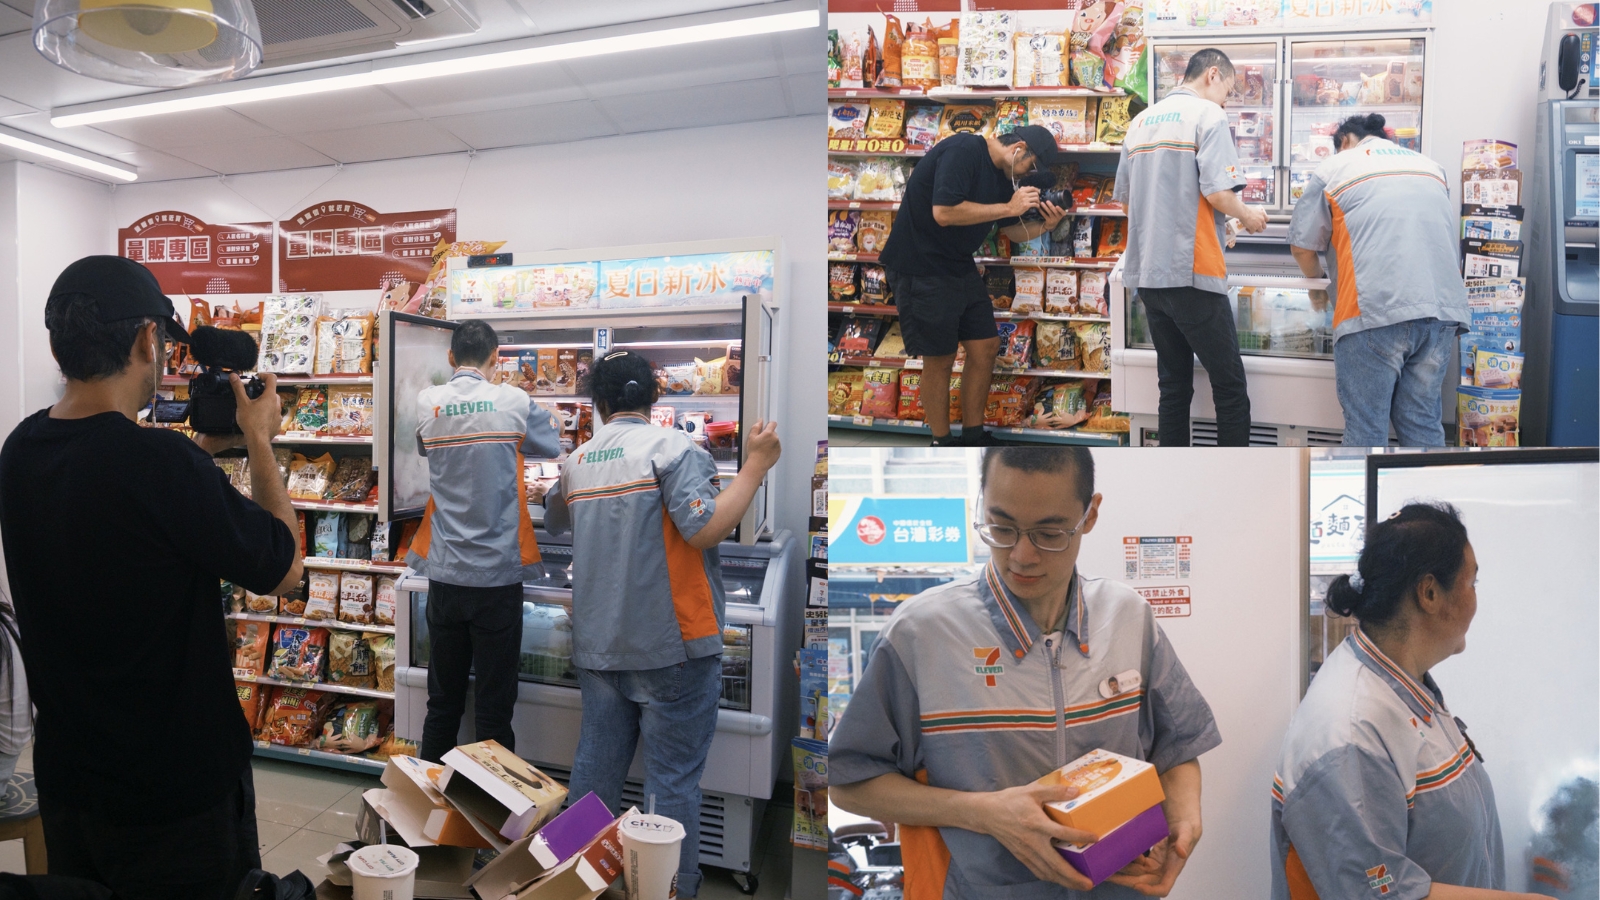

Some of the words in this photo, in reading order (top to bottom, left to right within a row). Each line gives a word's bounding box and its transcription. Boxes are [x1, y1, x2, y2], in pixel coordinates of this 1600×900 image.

[126, 235, 211, 262] 量販專區
[285, 225, 385, 259] 量販專區
[605, 263, 727, 299] 夏日新冰
[893, 525, 961, 543] 台灣彩券
